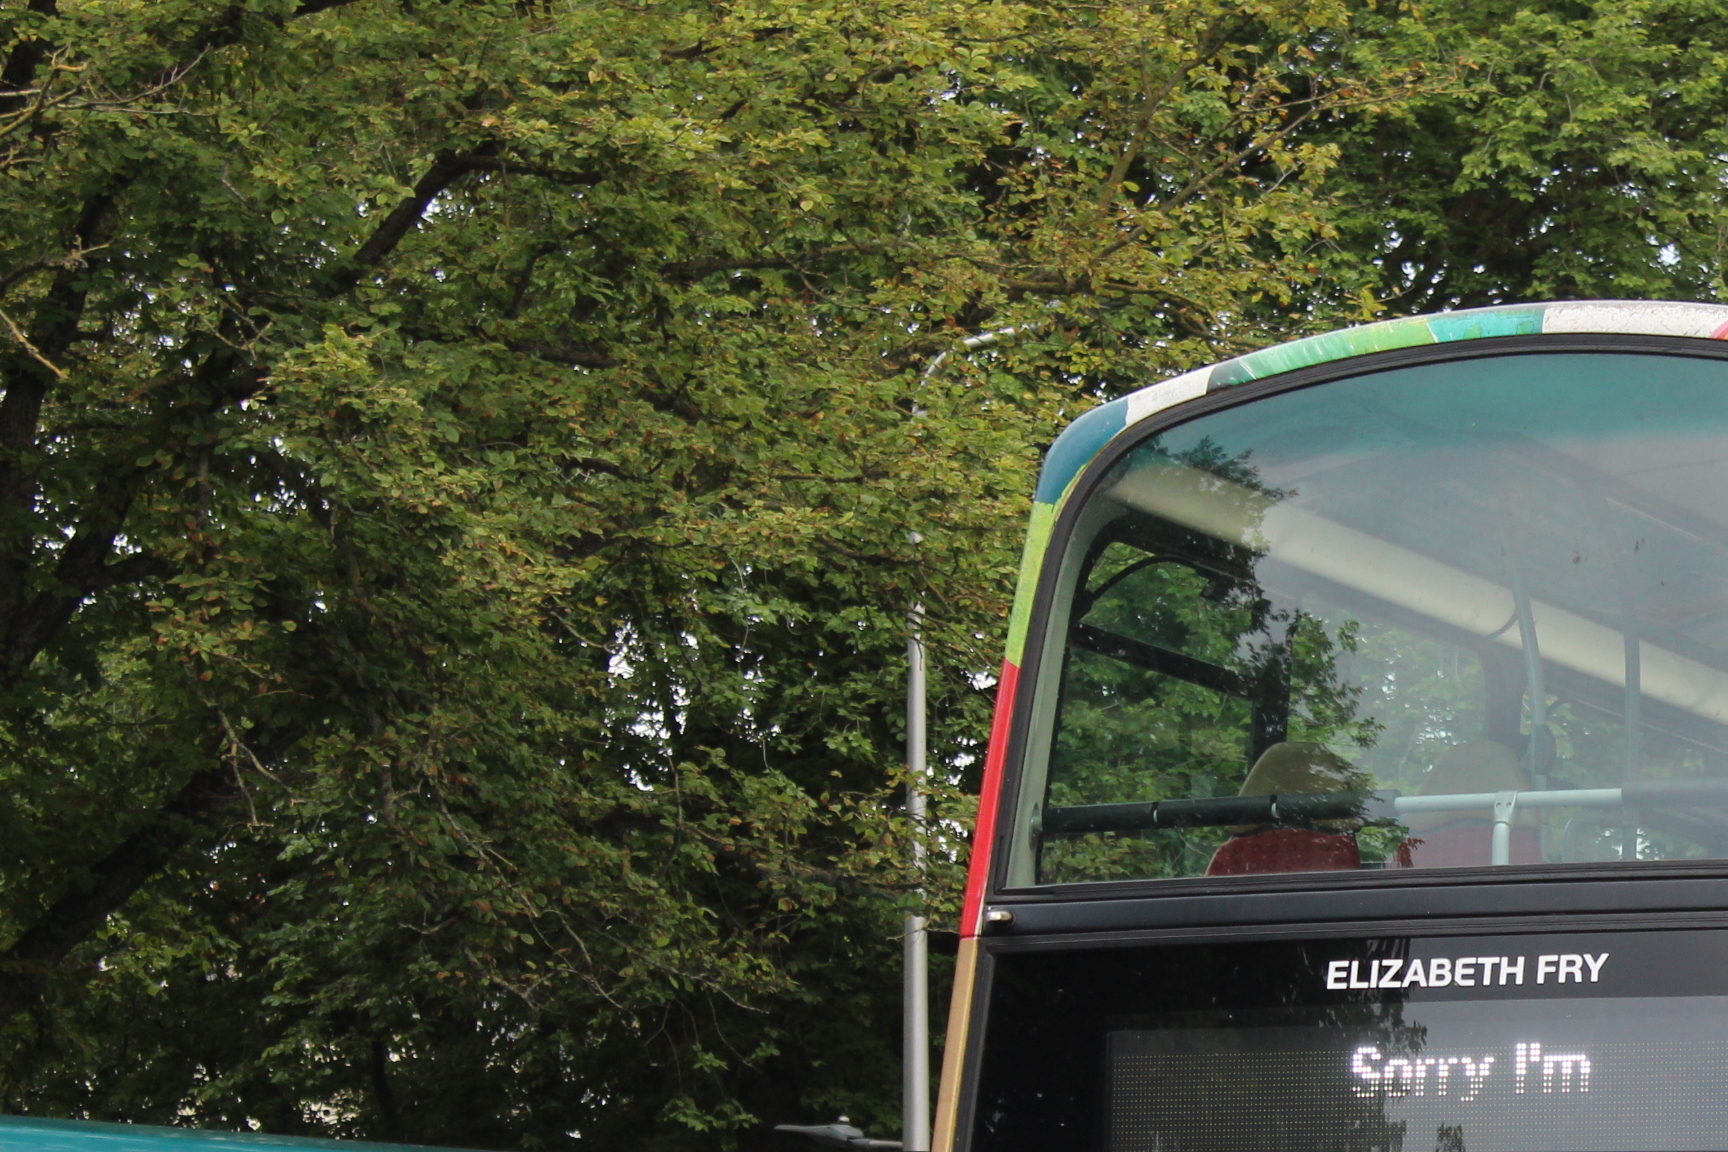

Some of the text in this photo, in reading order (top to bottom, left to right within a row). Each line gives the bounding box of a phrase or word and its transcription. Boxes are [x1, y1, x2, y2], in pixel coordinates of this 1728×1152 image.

[1326, 952, 1610, 990] ELIZABETH FRY
[1352, 1042, 1591, 1102] Sorry I'm
